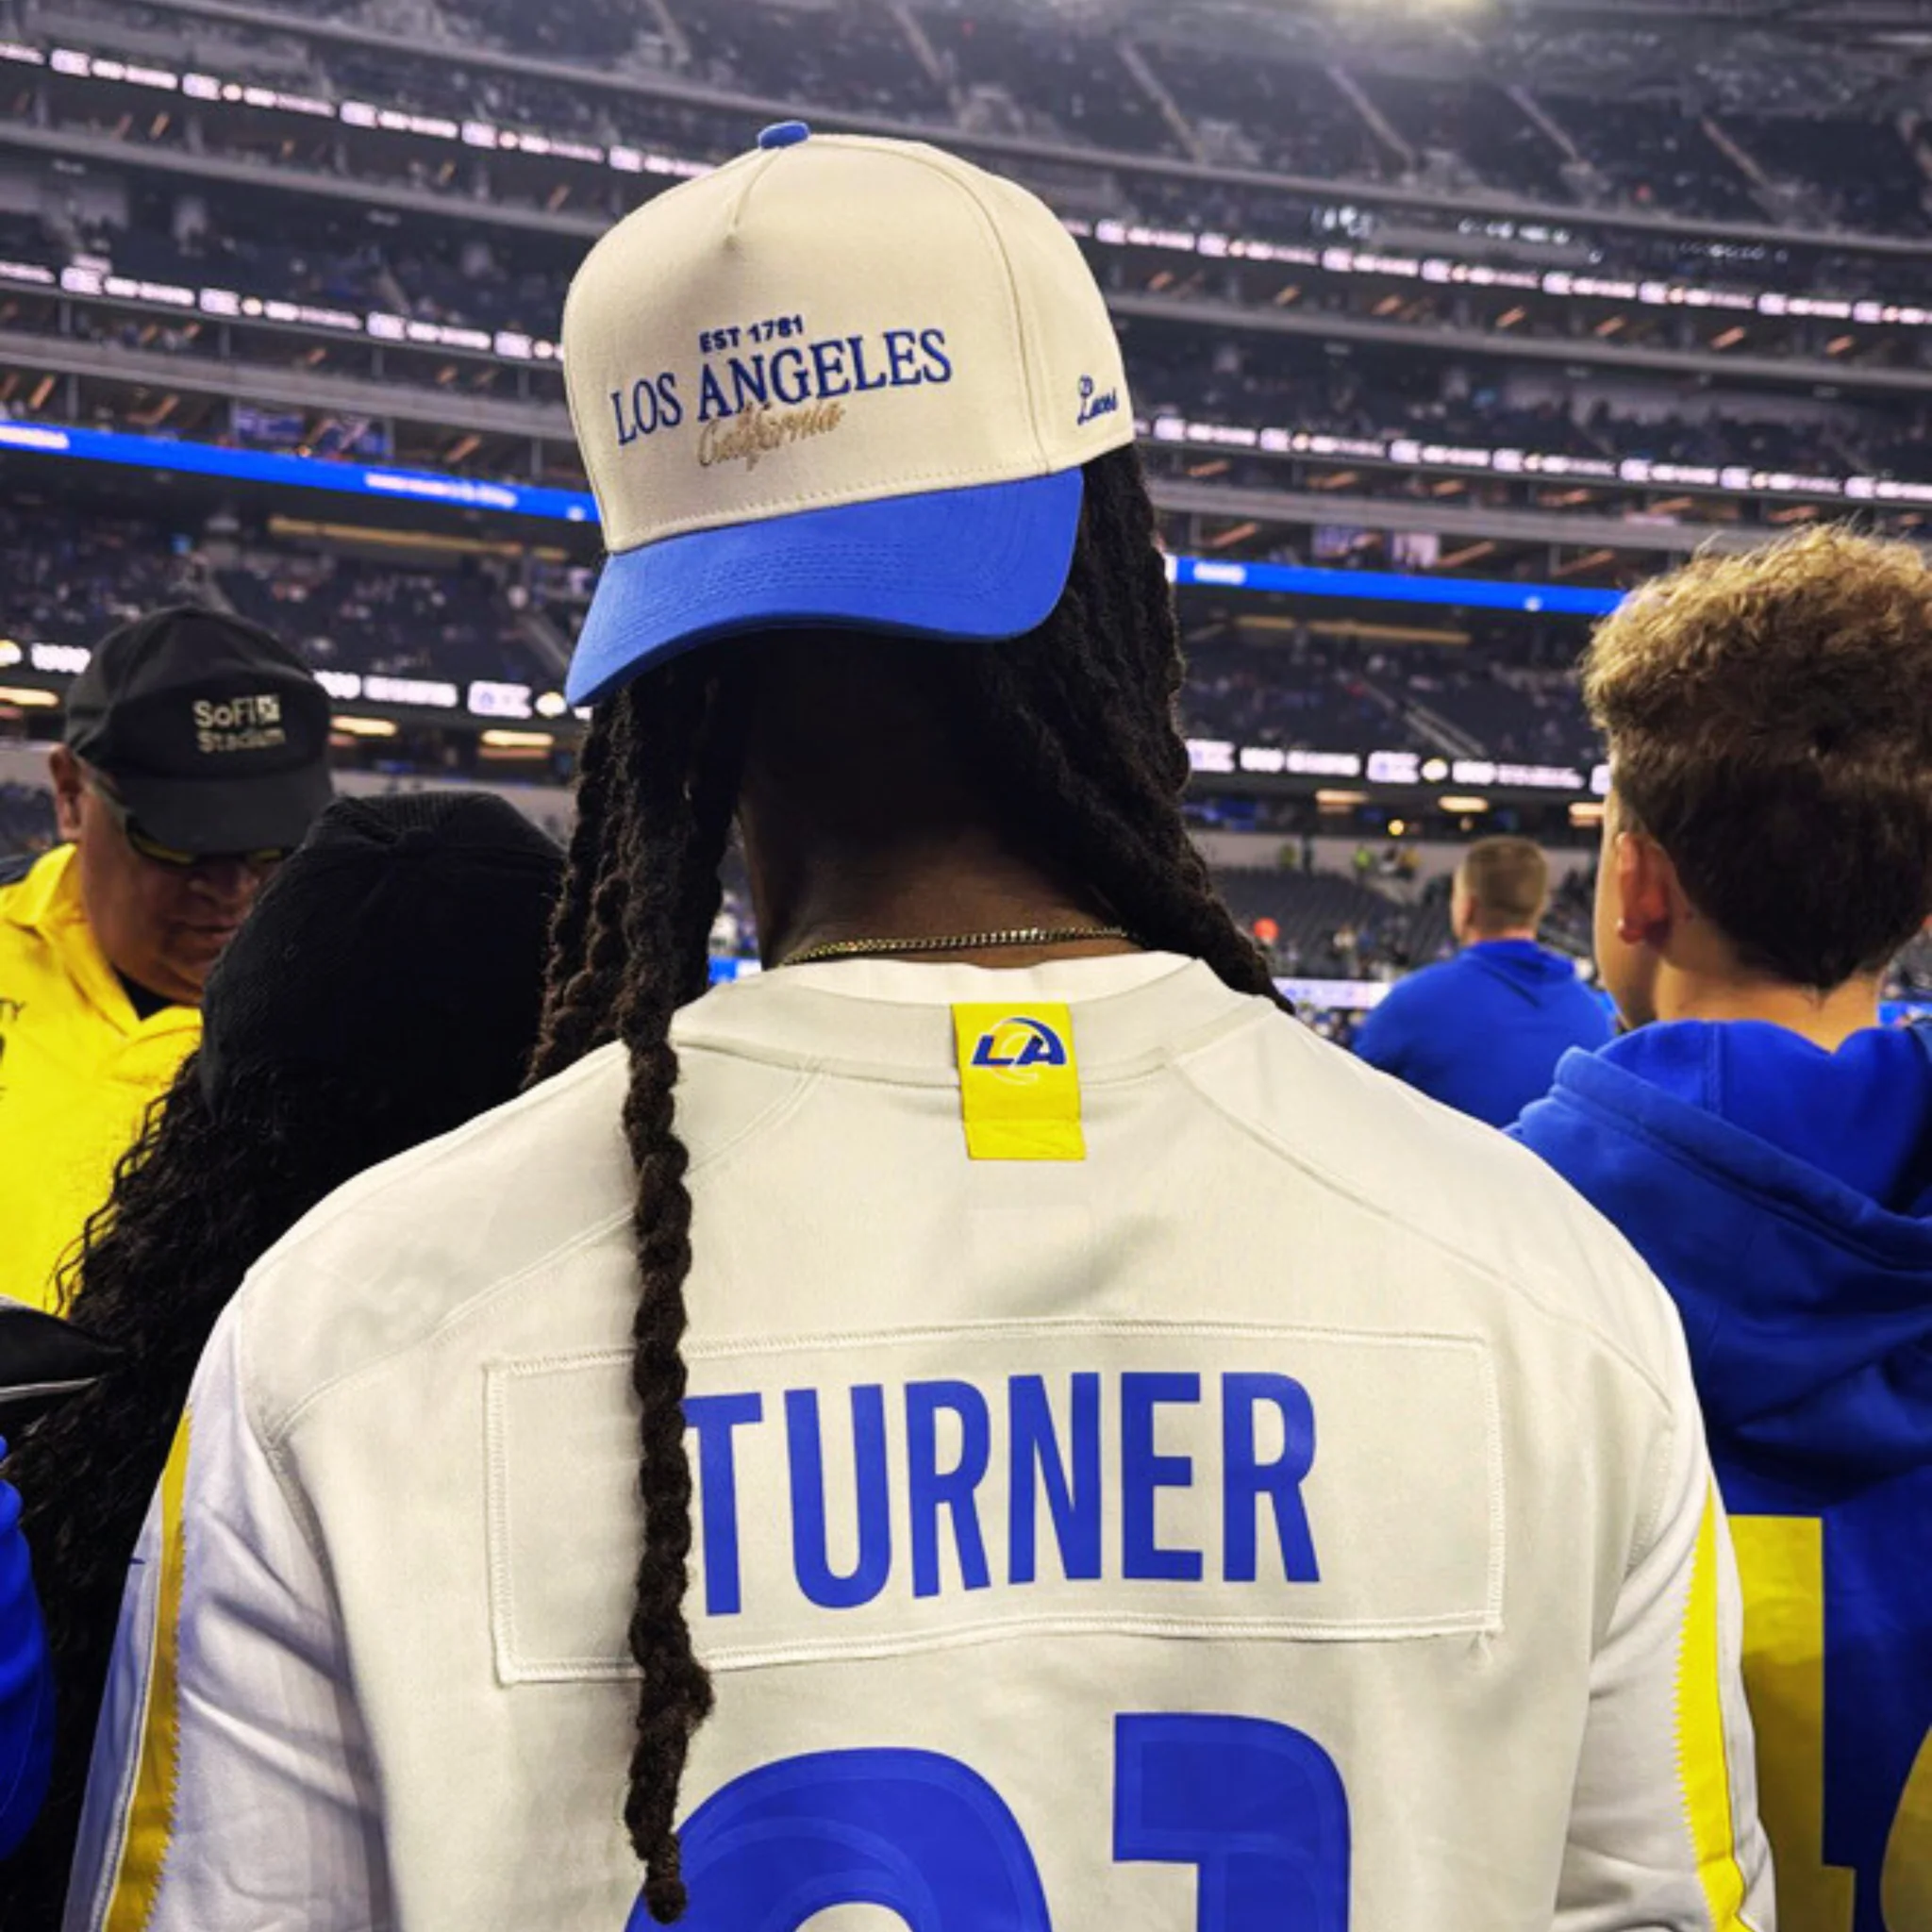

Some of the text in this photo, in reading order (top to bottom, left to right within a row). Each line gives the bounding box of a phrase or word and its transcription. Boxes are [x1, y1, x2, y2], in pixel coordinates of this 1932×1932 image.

[699, 314, 803, 354] EST 1781
[610, 328, 951, 446] LOS ANGELES
[697, 401, 846, 472] California
[682, 1372, 1321, 1616] TURNER
